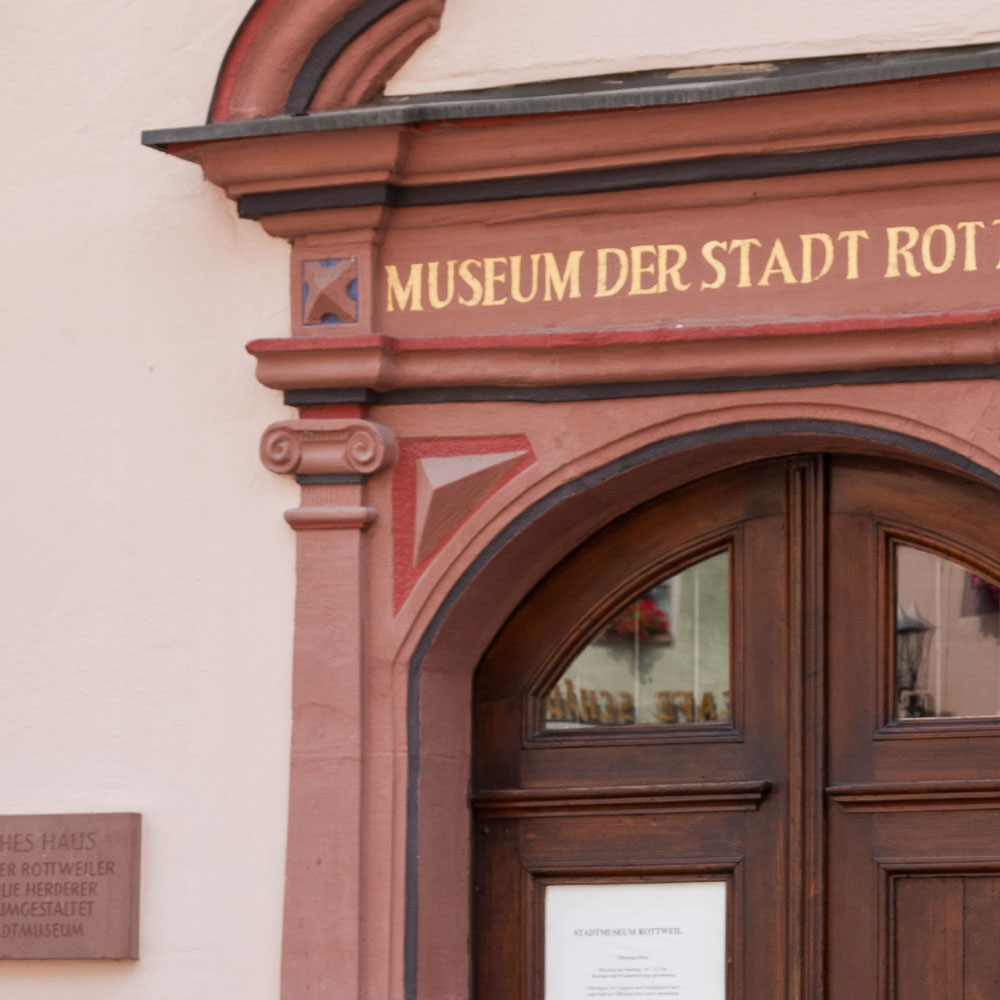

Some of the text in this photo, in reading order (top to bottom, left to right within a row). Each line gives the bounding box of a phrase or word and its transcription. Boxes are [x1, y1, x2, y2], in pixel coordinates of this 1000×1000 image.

[385, 250, 585, 312] MUSEUM
[594, 244, 691, 297] DER
[700, 229, 869, 291] STADT
[42, 832, 97, 851] HAUS
[21, 860, 116, 877] ROTTWEILER
[26, 881, 98, 897] HERDERER
[638, 927, 683, 936] ROTTWEIL
